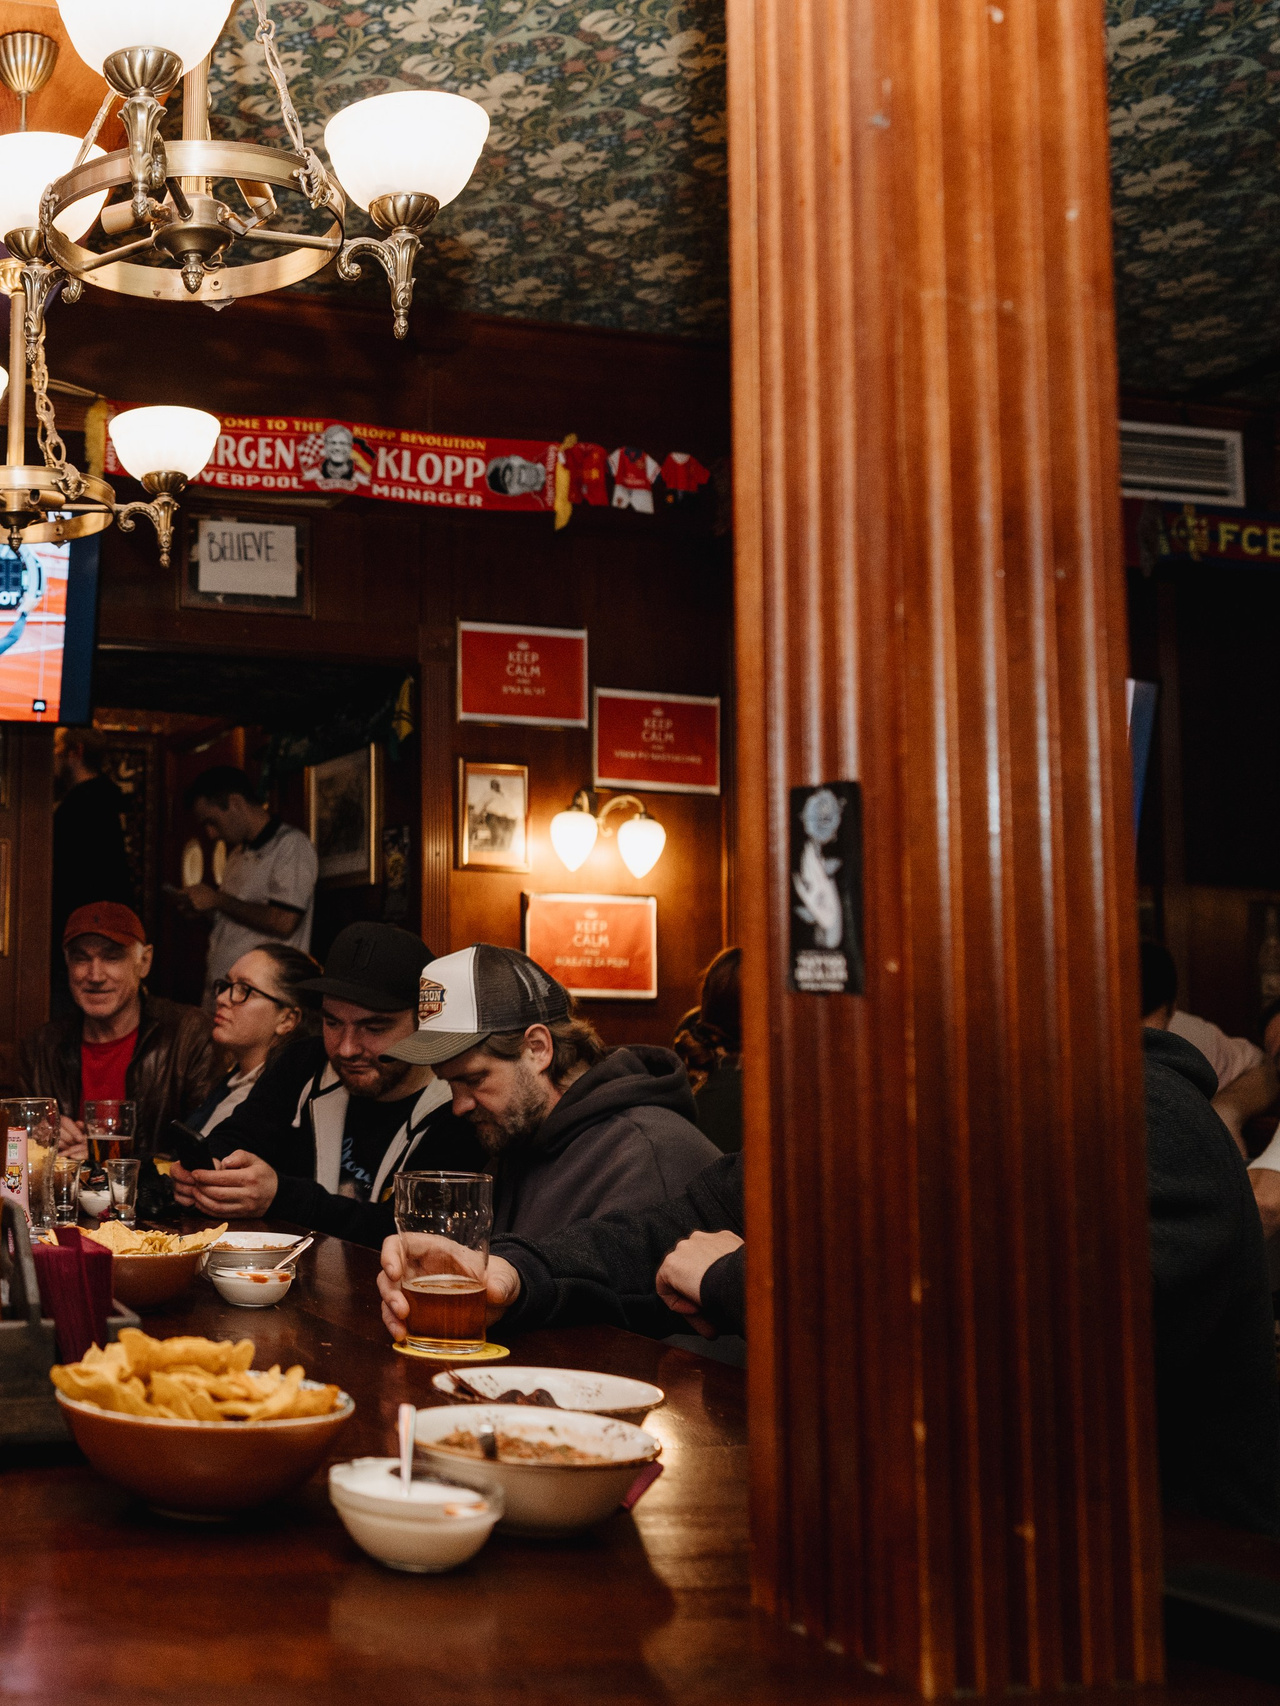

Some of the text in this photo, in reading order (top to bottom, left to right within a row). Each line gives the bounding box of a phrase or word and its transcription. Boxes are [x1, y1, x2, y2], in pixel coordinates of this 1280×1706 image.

[265, 419, 288, 431] TO
[293, 421, 325, 433] THE
[352, 425, 397, 441] KLOPP
[399, 431, 487, 451] REVOLUTION
[208, 434, 487, 488] RGEN KLOPP
[195, 470, 305, 490] IVERPOOL
[371, 483, 484, 508] MANAGER
[207, 531, 277, 562] BELIEVE
